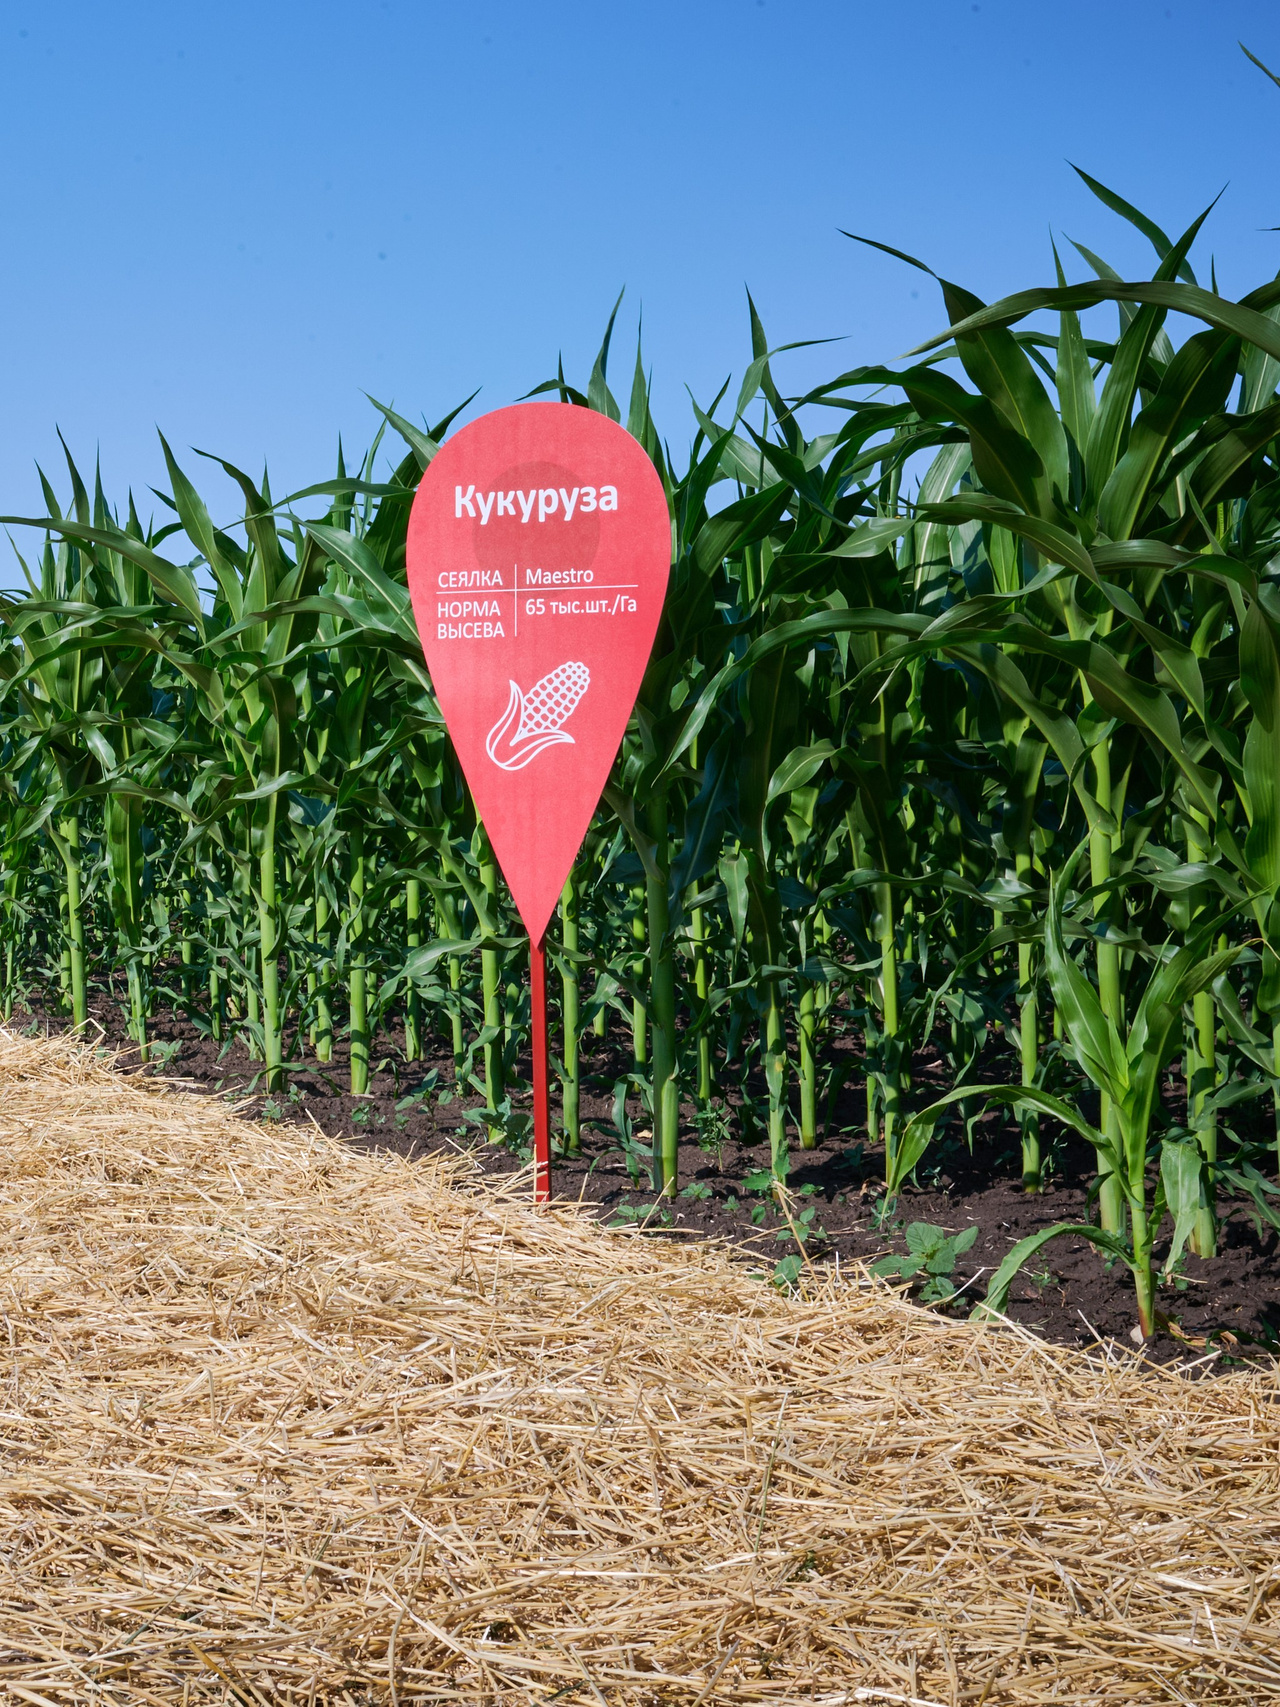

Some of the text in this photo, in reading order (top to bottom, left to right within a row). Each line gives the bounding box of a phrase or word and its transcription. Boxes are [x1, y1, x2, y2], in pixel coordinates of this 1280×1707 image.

[454, 484, 617, 525] Кукуруза
[437, 569, 503, 588] СЕЯЛКА
[525, 567, 593, 584] Maestro
[437, 599, 501, 618] НОРМА
[525, 594, 637, 615] 65 тыс.шт./Га
[437, 621, 505, 639] ВЫСЕВА
